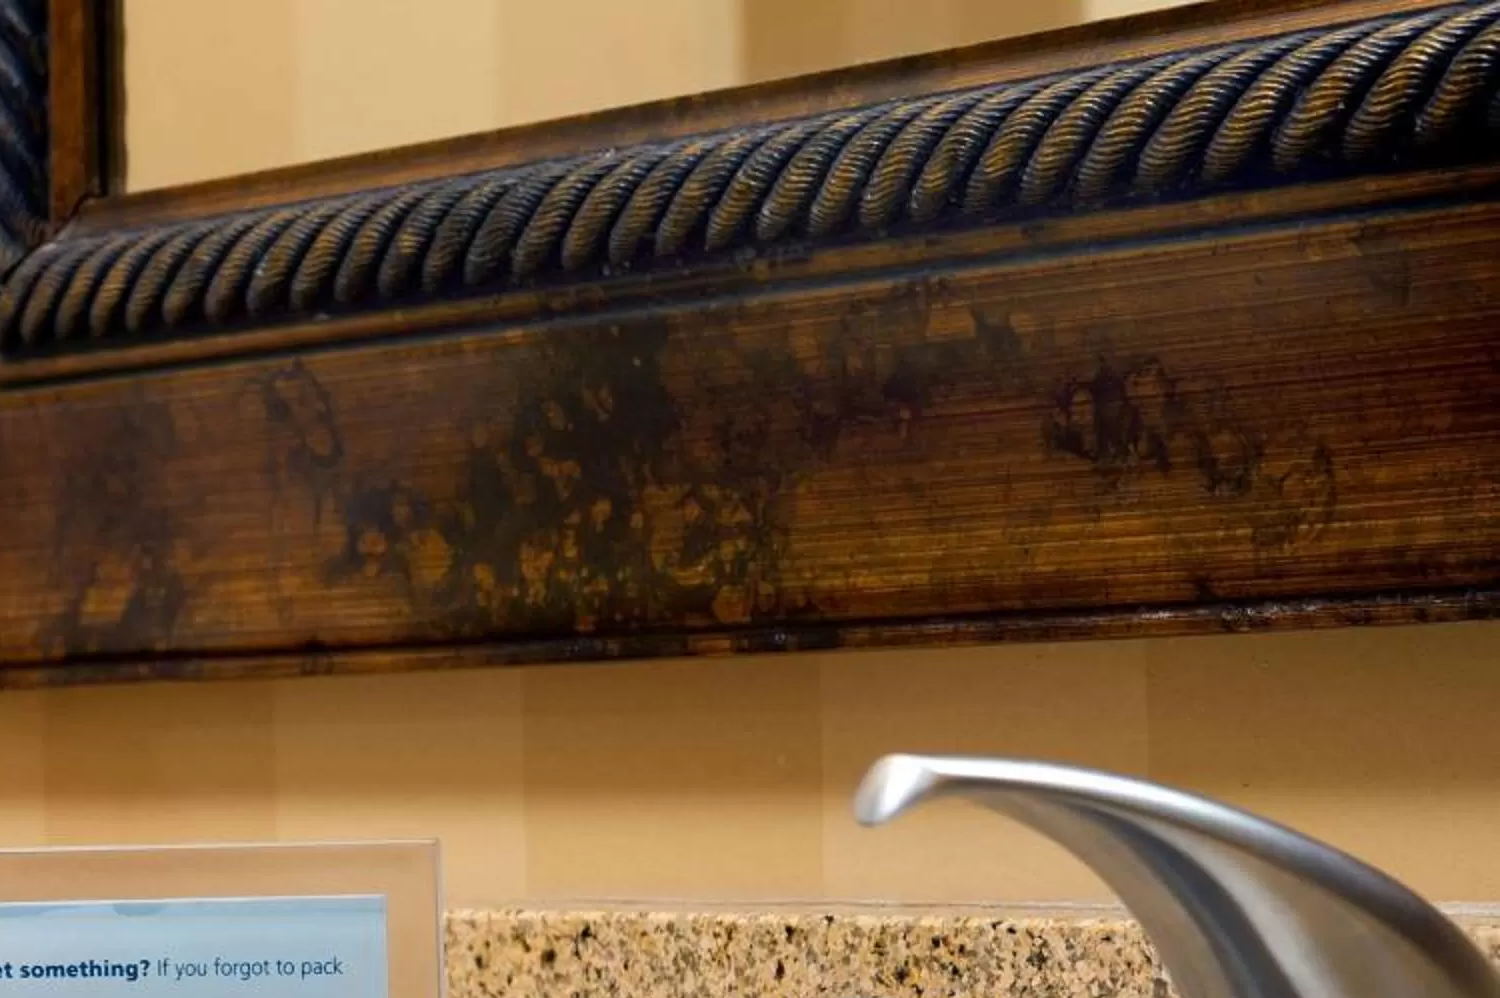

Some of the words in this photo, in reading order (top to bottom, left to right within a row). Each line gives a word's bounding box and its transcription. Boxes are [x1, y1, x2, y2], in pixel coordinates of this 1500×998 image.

[19, 959, 151, 982] something?
[156, 958, 170, 977] If
[175, 964, 208, 981] you
[214, 957, 270, 981] forgot
[276, 959, 295, 976] to
[301, 956, 344, 979] pack
